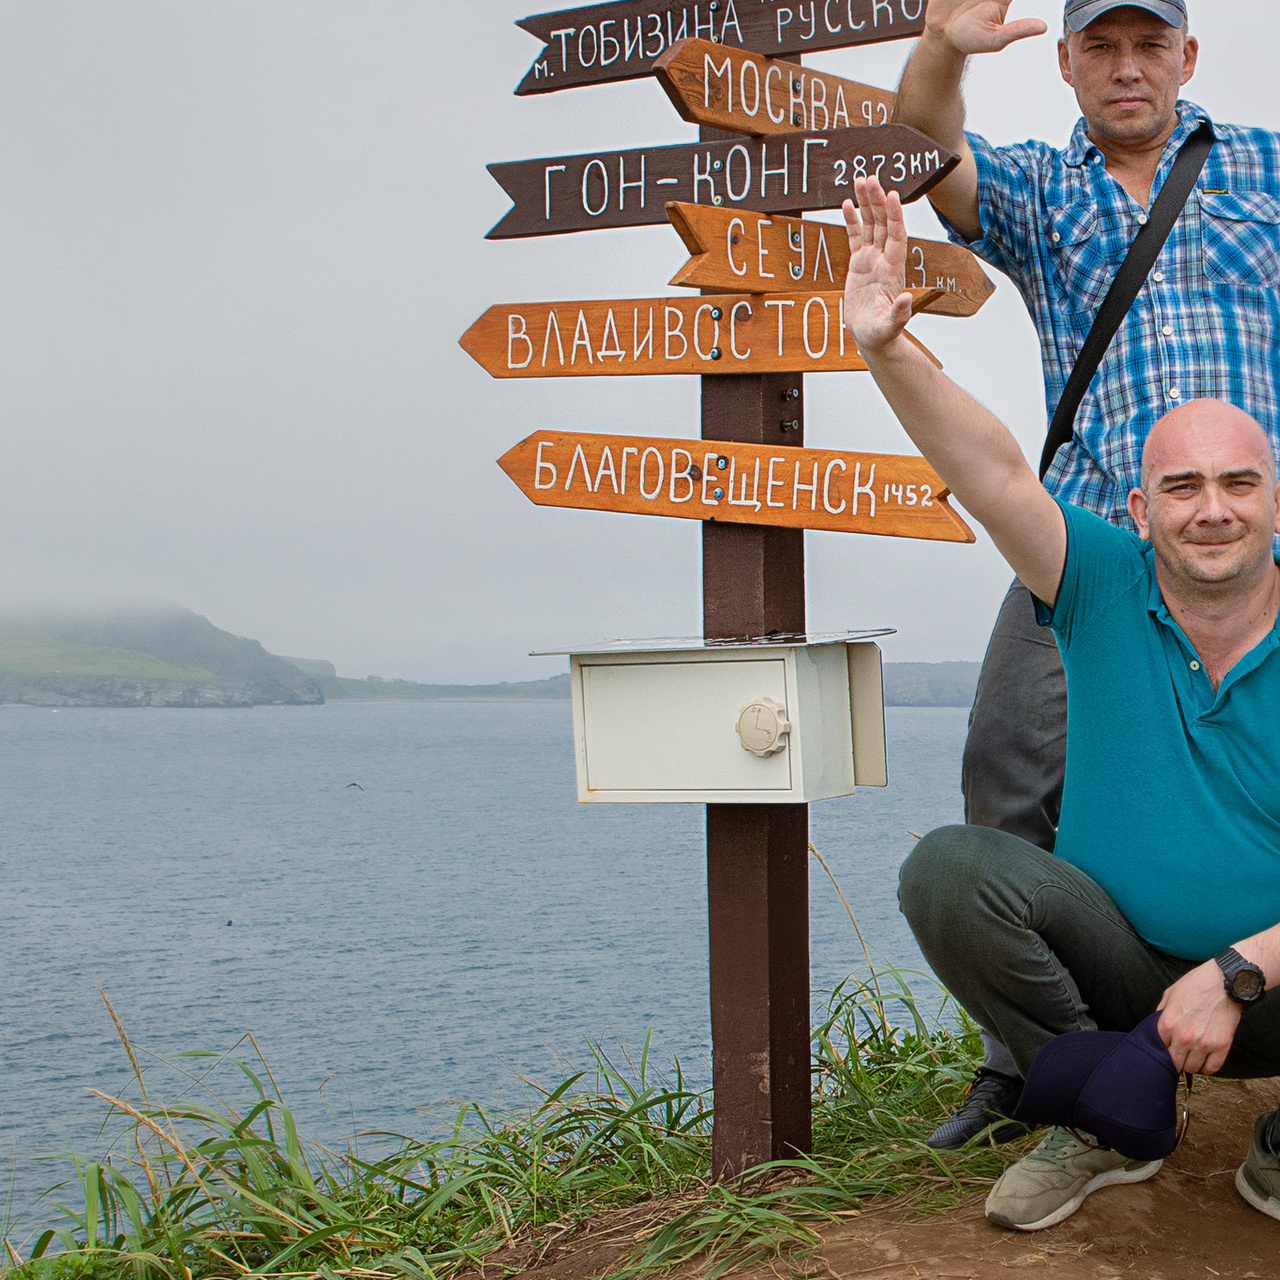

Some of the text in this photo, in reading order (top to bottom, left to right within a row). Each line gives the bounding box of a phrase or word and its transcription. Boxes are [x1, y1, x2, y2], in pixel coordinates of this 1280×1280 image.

[704, 52, 850, 132] МОСКВА
[543, 138, 829, 219] ГОН-КОНГ
[726, 216, 835, 280] СЕУЛ
[534, 441, 934, 518] БЛАГОВЕЩЕНСК 1452
